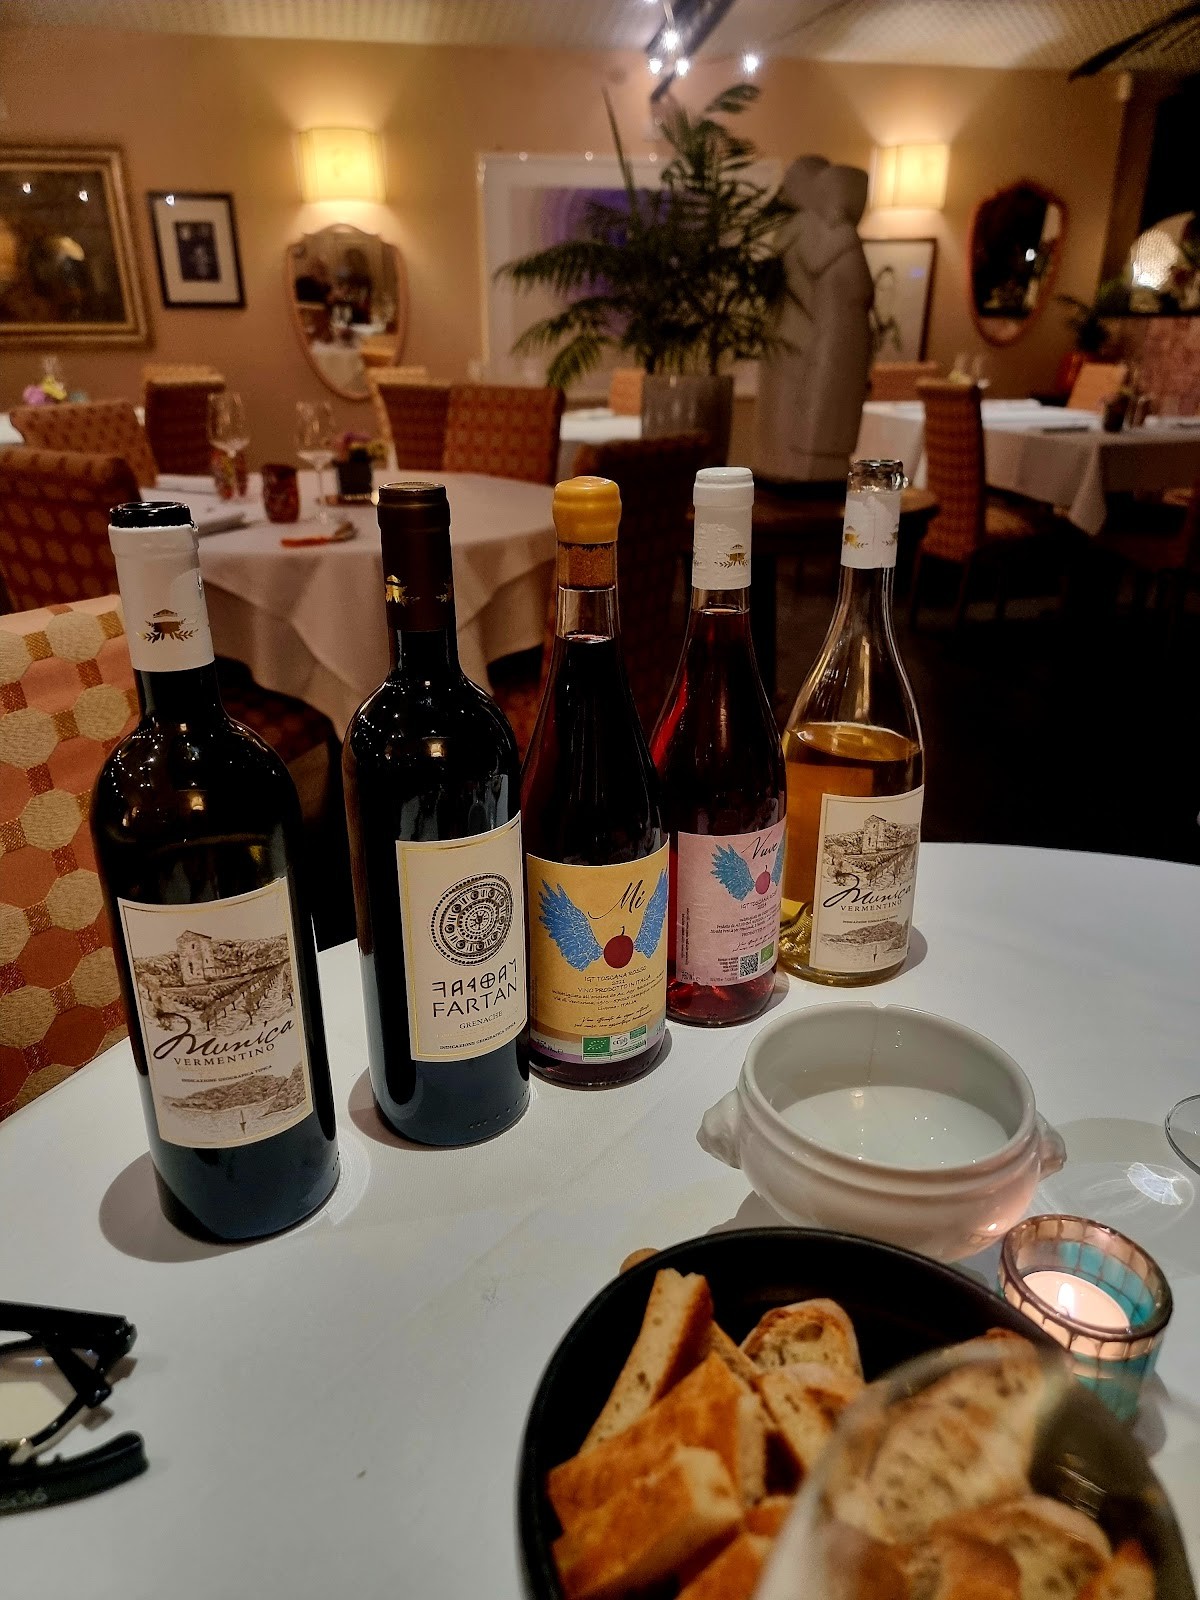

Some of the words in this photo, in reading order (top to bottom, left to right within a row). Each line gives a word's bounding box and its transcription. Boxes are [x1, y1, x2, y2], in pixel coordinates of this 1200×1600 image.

[822, 872, 912, 908] Munica
[840, 900, 903, 912] VERMENTINO
[594, 983, 628, 993] PRODOTTO
[636, 974, 651, 986] ITALIA
[596, 972, 627, 982] TOSCANA
[432, 976, 518, 1018] FARTAN
[459, 1009, 503, 1030] GRENACHE
[152, 1011, 295, 1060] Munica
[173, 1043, 275, 1067] VERMENTINO
